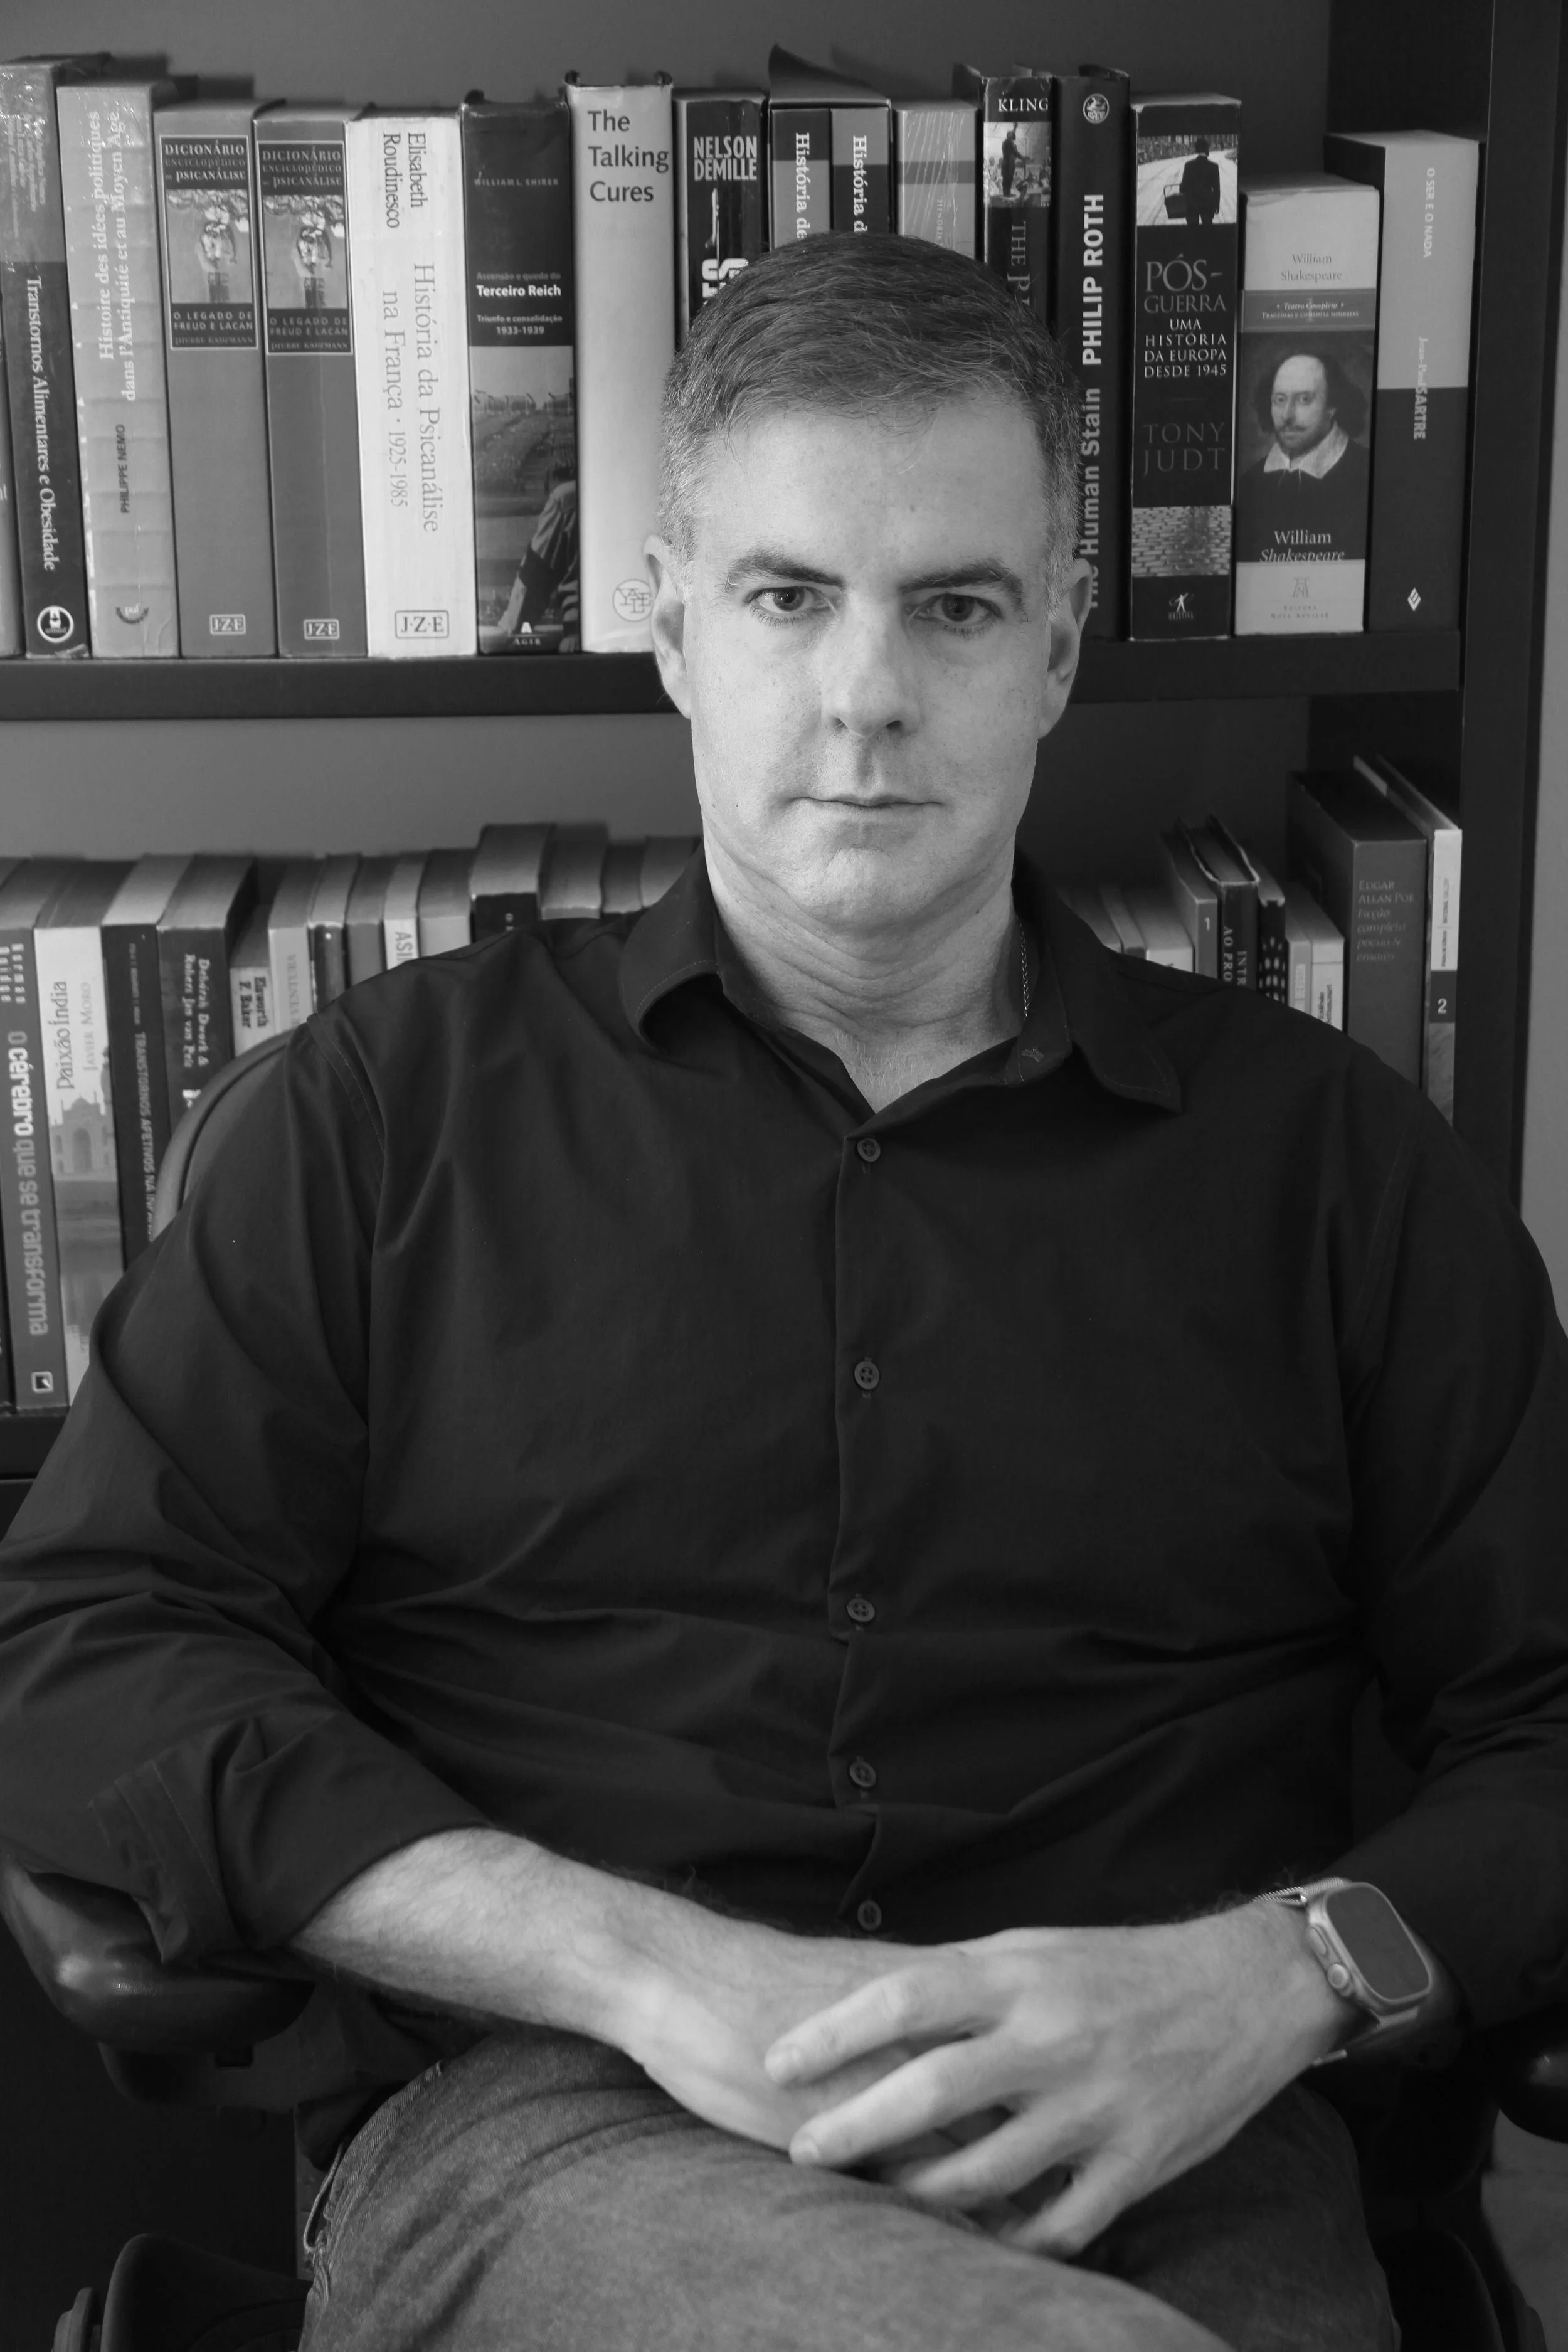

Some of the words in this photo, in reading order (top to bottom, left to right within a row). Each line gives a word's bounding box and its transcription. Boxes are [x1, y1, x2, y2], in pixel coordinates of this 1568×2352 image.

[998, 97, 1049, 112] KLING
[587, 109, 630, 132] The
[87, 111, 107, 201] politiques
[165, 139, 245, 156] DICIONÁRIO
[262, 146, 341, 162] DICIONÁRIO
[588, 144, 669, 174] Talking
[694, 135, 757, 159] NELSON
[176, 167, 246, 184] PSICANÁLISE
[262, 162, 342, 174] ENCICLOPÉDICO
[383, 132, 403, 228] Roudinesco
[408, 132, 429, 209] Elisabeth
[694, 158, 757, 181] DEMILLE
[795, 132, 811, 214] História
[852, 135, 869, 216] História
[1426, 167, 1435, 177] O
[110, 152, 127, 214] Moyen
[273, 173, 342, 189] PSICANÁLISE
[590, 181, 654, 203] Cures
[1425, 179, 1434, 201] SER
[92, 204, 108, 250] idées
[115, 217, 127, 239] au
[796, 217, 811, 240] de
[1424, 213, 1433, 223] O
[1083, 194, 1103, 267] ROTH
[1423, 225, 1433, 258] NADA
[115, 241, 129, 261] et
[1011, 221, 1026, 266] THE
[94, 254, 110, 284] des
[1292, 253, 1332, 264] William
[1144, 253, 1222, 292] PÓS-
[1281, 270, 1343, 283] Shakespeare
[475, 284, 526, 297] Terceiro
[528, 284, 562, 297] Reich
[174, 311, 181, 320] O
[187, 311, 233, 320] LEGADO
[238, 311, 252, 320] DE
[383, 291, 400, 319] na
[414, 263, 438, 359] História
[1144, 294, 1227, 314] GUERRA
[1284, 302, 1305, 310] Teatro
[26, 275, 45, 373] Transtornos
[98, 289, 114, 360] Histoire
[174, 322, 206, 331] FREUD
[210, 322, 216, 331] E
[220, 321, 253, 331] LACAN
[270, 317, 277, 326] O
[283, 317, 329, 326] LEGADO
[334, 317, 347, 326] DE
[270, 327, 302, 336] FREUD
[306, 327, 311, 336] E
[315, 327, 348, 336] LACAN
[496, 326, 545, 335] 1933-1939
[512, 315, 563, 324] consolidação
[1082, 276, 1103, 366] PHILIP
[1170, 318, 1201, 331] UMA
[1145, 331, 1227, 347] HISTÓRIA
[1145, 349, 1164, 363] DA
[1170, 348, 1227, 363] EUROPA
[1417, 337, 1428, 386] Jean-Paul
[121, 361, 137, 401] dans
[383, 329, 406, 411] França
[1144, 364, 1190, 378] DESDE
[1197, 363, 1227, 377] 1945
[418, 369, 439, 398] da
[33, 376, 50, 472] Alimentares
[1081, 388, 1101, 457] Stain
[1413, 386, 1428, 440] SARTRE
[115, 423, 127, 461] NEMO
[1143, 422, 1225, 444] TONY
[389, 430, 409, 508] 1925-1985
[420, 407, 443, 532] Psicanálise
[1143, 448, 1225, 479] JUDT
[40, 474, 50, 484] e
[117, 465, 129, 513] PHILIPPE
[1080, 466, 1101, 556] Human
[40, 487, 60, 571] Obesidade
[1274, 529, 1332, 545] William
[1259, 548, 1345, 563] Shakespeare
[1358, 894, 1392, 904] ALLAN
[1395, 891, 1415, 903] POE
[1359, 880, 1395, 891] EDGAR
[1204, 916, 1210, 931] 1
[395, 931, 414, 962] ASI
[1223, 926, 1233, 947] AO
[184, 954, 196, 994] Robert
[1223, 953, 1233, 982] PRO
[181, 996, 195, 1017] Jan
[1437, 998, 1447, 1015] 2
[184, 1020, 193, 1041] van
[197, 1013, 211, 1052] Dwork
[53, 1027, 75, 1090] Paixão
[198, 1055, 209, 1066] &
[135, 1031, 151, 1117] TRANSTORNOS
[8, 1047, 34, 1137] cérebro
[140, 1118, 156, 1173] AFETIVOS
[13, 1138, 37, 1178] que
[19, 1180, 40, 1206] se
[144, 1175, 156, 1192] NA
[21, 1208, 49, 1336] transforma
